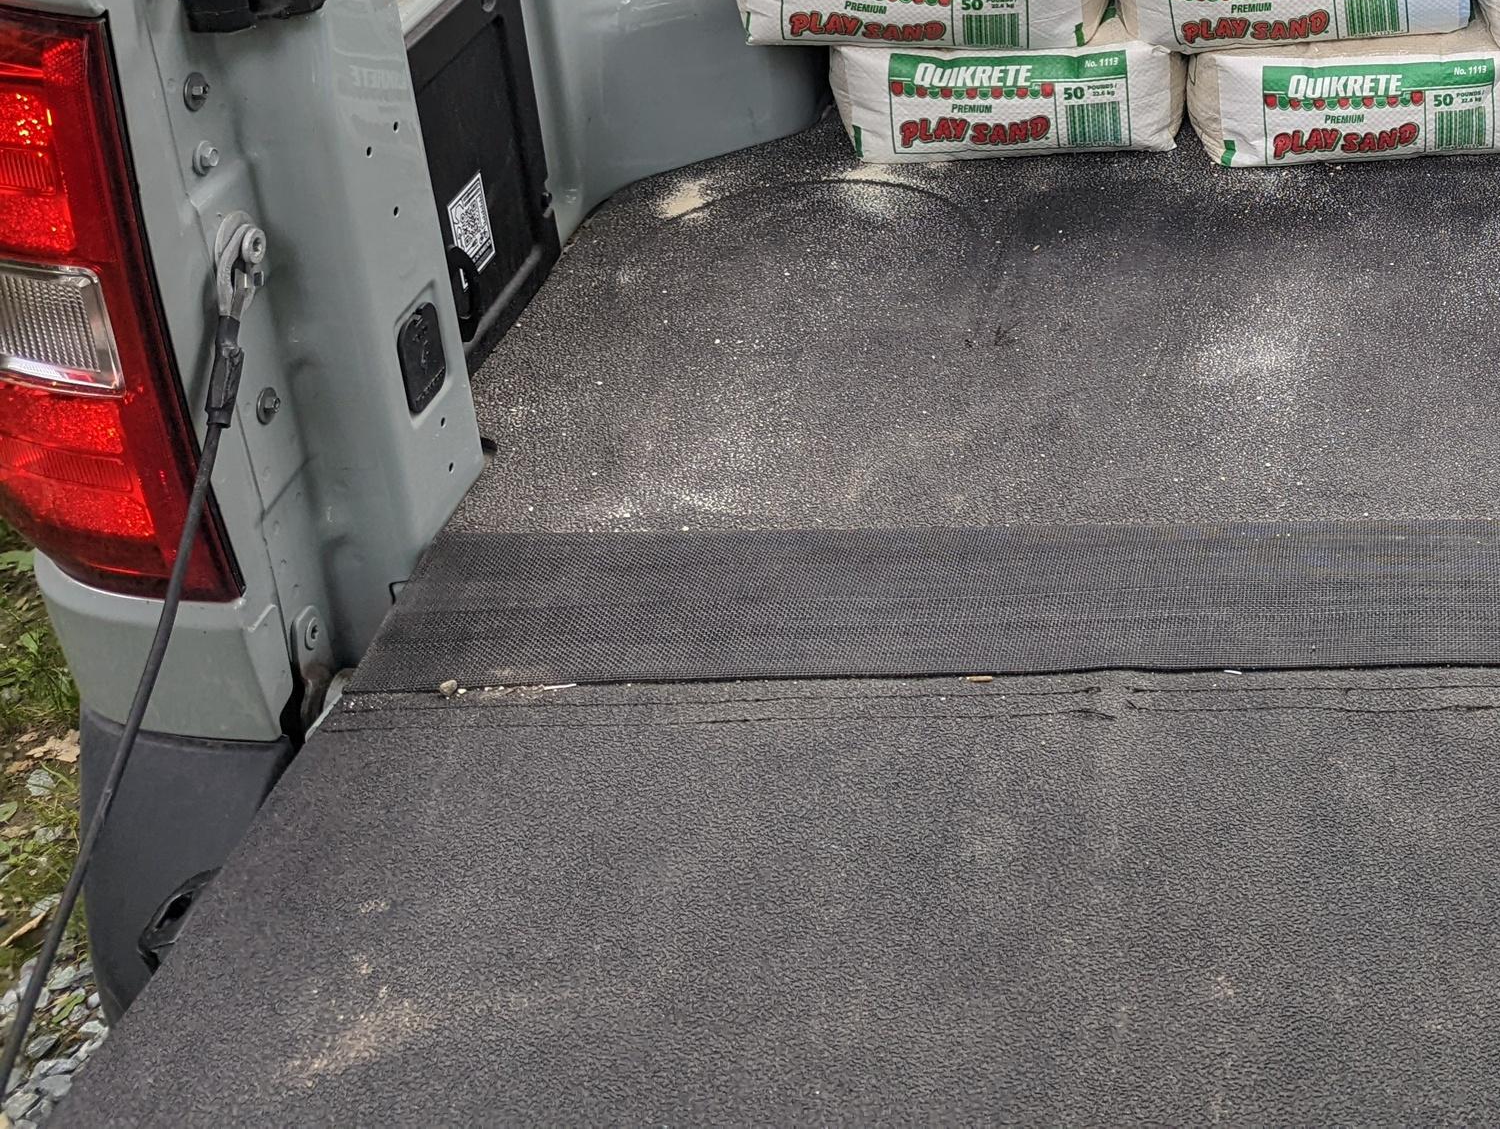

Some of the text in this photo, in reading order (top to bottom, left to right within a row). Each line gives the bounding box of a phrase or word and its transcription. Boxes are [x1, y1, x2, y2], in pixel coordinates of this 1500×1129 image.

[844, 0, 887, 15] PREMIUM
[1231, 2, 1272, 14] PREMIUM
[789, 11, 946, 41] PLAY SAND
[1181, 9, 1330, 43] PLAY SAND
[1085, 57, 1119, 68] No. 1113
[914, 63, 1032, 87] QUIKRETE
[1454, 65, 1487, 75] No. 1113
[1064, 86, 1085, 100] 50
[1288, 74, 1402, 99] QUIKRETE
[1434, 94, 1454, 107] 50
[951, 104, 992, 113] PREMIUM
[1324, 114, 1364, 124] PREMIUM
[900, 115, 1050, 148] PLAY SAND
[1273, 122, 1419, 160] PLAY SAND
